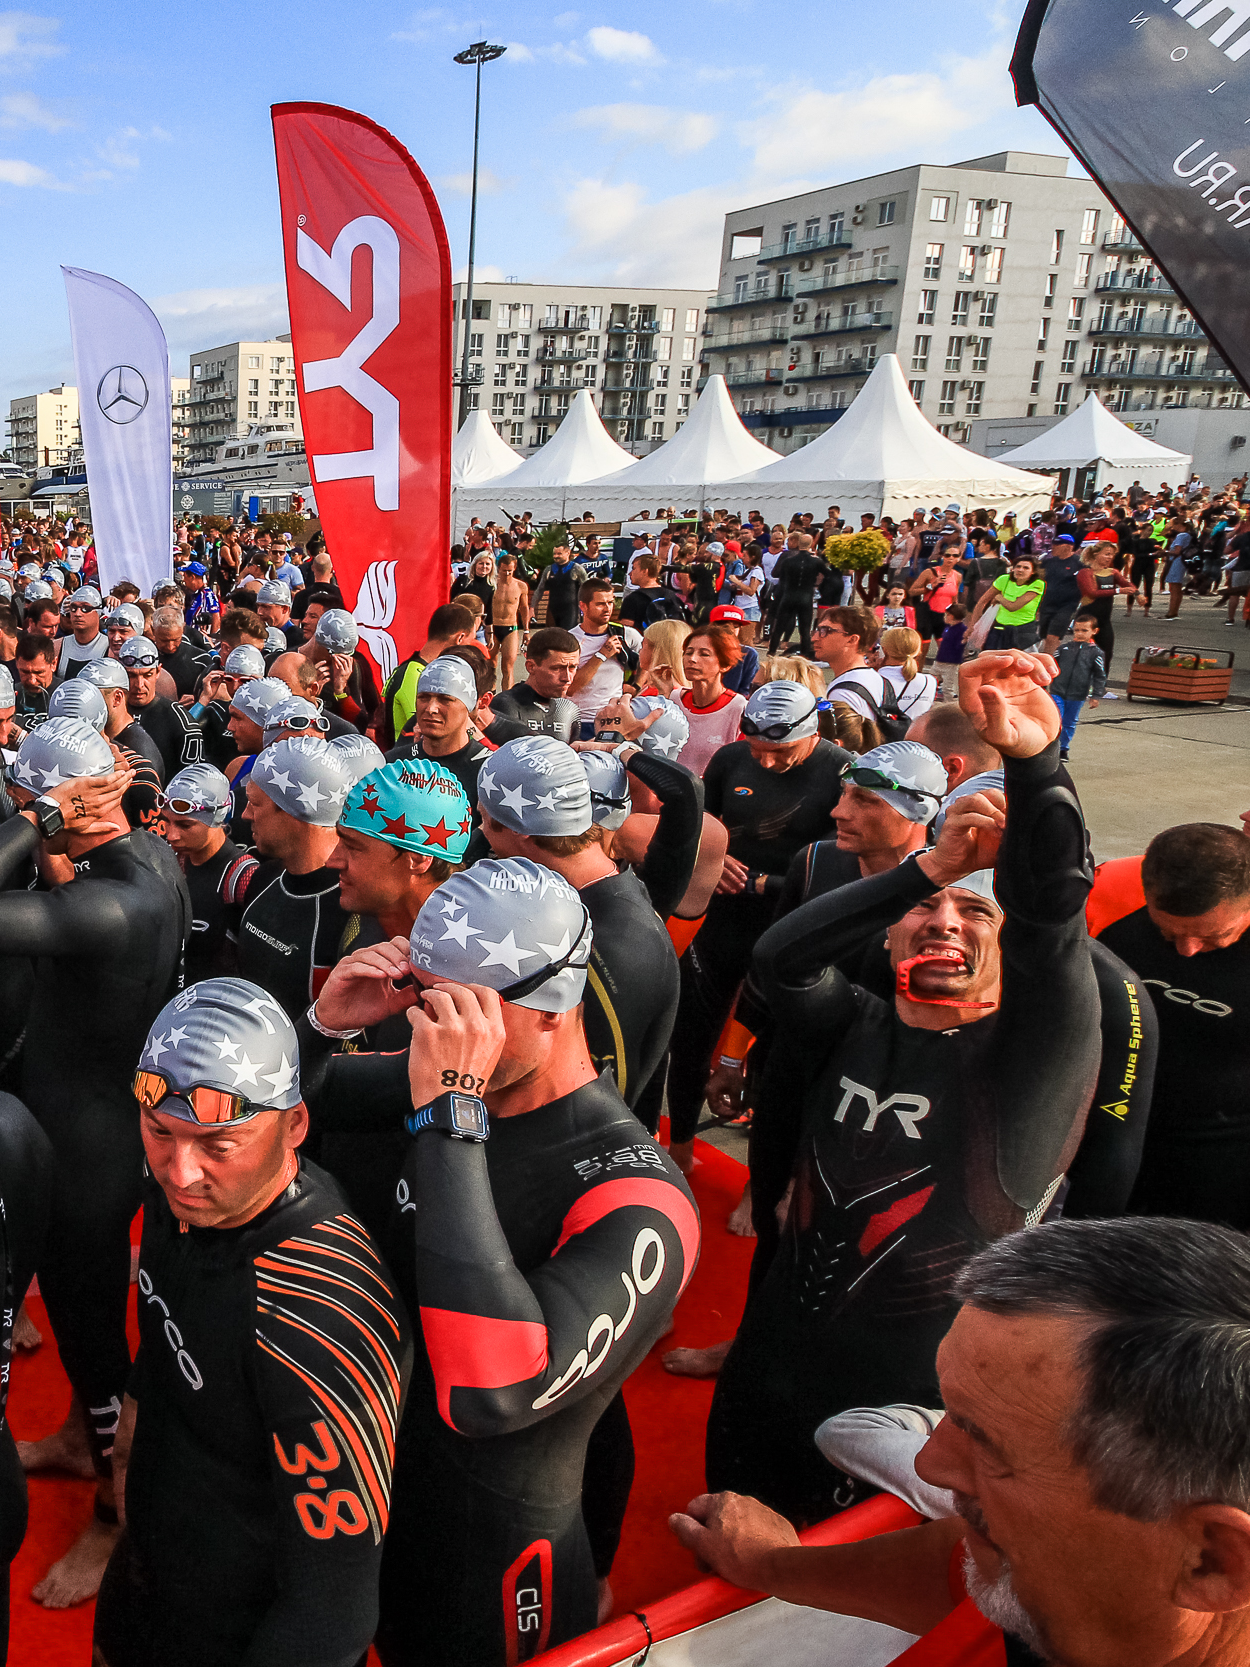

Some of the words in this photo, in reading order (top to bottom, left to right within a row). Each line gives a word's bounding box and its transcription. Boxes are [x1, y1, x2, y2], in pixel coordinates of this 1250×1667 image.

[191, 481, 223, 490] SERVICE
[1125, 983, 1144, 1050] Sphere
[1141, 979, 1233, 1017] rca
[440, 1068, 486, 1096] 208
[1119, 1053, 1139, 1096] Aqua
[833, 1075, 930, 1139] TYR
[138, 1268, 204, 1391] orca
[531, 1227, 666, 1410] orca
[272, 1418, 370, 1540] 3.8
